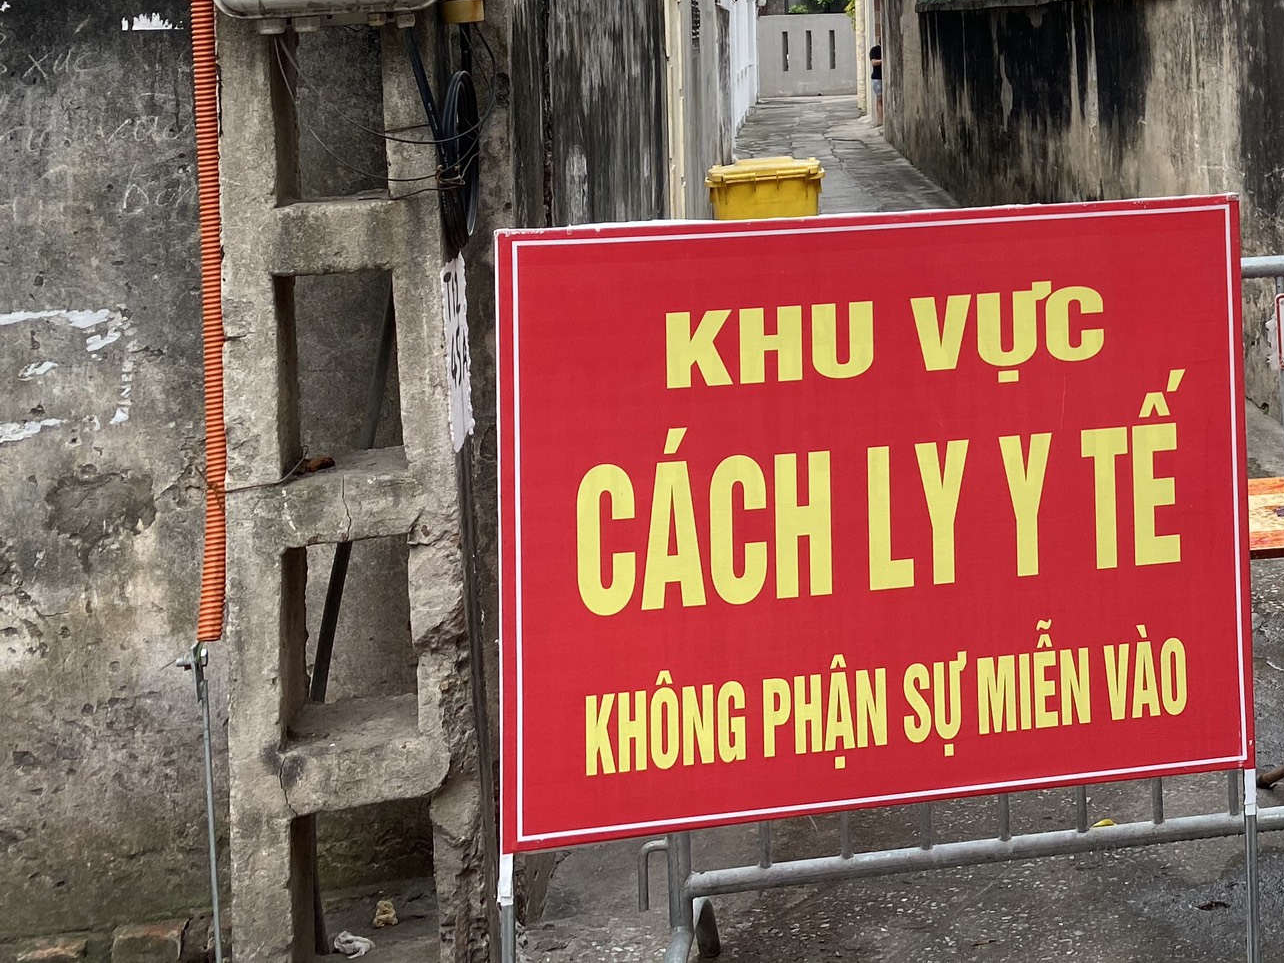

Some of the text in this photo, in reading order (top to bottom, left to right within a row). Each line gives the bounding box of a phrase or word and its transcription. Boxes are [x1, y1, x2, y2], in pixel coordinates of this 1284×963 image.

[665, 280, 1105, 389] KHU VỰC
[576, 369, 1187, 616] CÁCH LY Y TẾ
[585, 619, 1189, 777] KHÔNG PHẬN SỰ MIỄN VÀO
